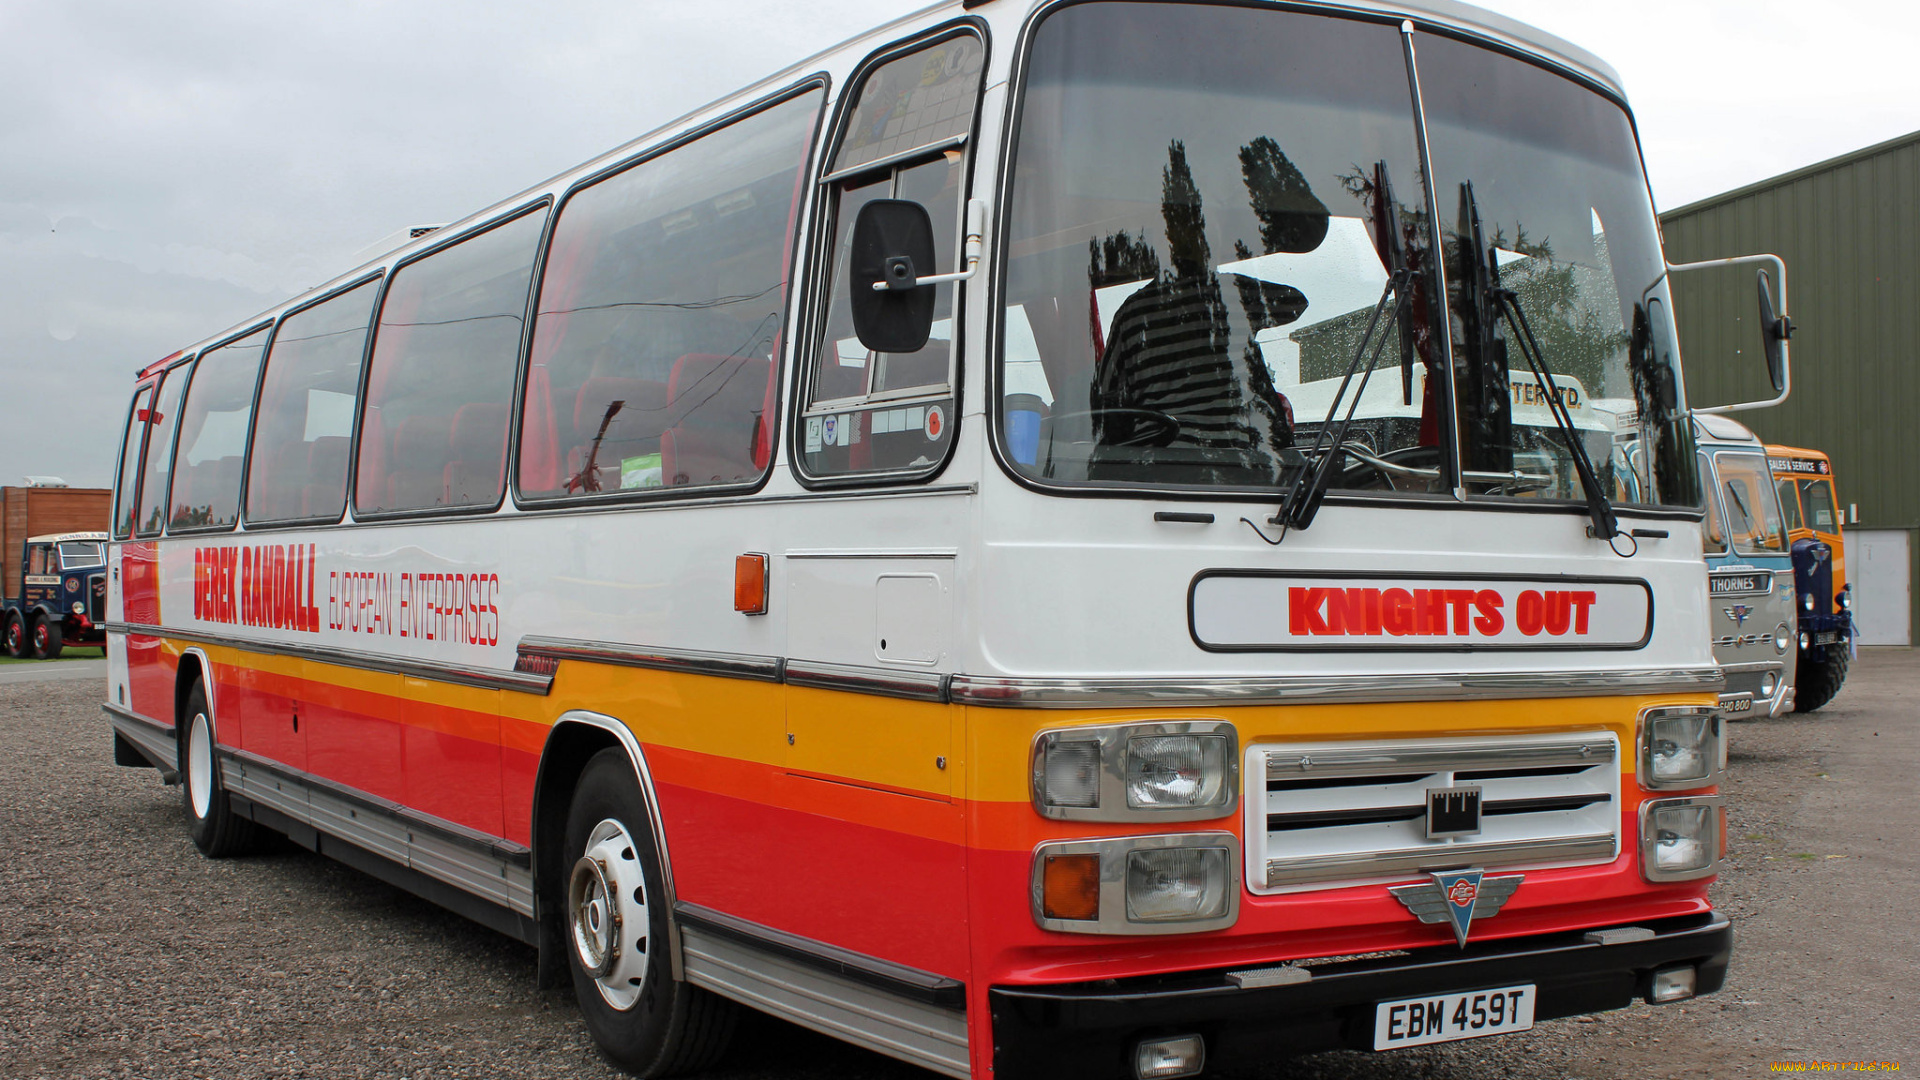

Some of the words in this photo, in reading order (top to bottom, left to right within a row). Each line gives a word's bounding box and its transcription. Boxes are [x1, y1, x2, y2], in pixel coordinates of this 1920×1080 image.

[1769, 459, 1787, 470] SALES
[1792, 461, 1815, 472] SERVICE
[1711, 577, 1755, 592] THORNES
[194, 546, 238, 624] DEREK
[241, 543, 320, 633] RANDALL
[329, 571, 393, 635] EUROPEAN
[400, 573, 499, 647] ENTERPRISES
[1288, 586, 1504, 636] KNIGHTS
[1516, 589, 1596, 636] OUT
[1735, 699, 1750, 711] 800
[1450, 886, 1474, 899] AEC
[1388, 1000, 1444, 1041] EBM
[1452, 990, 1524, 1031] 459T
